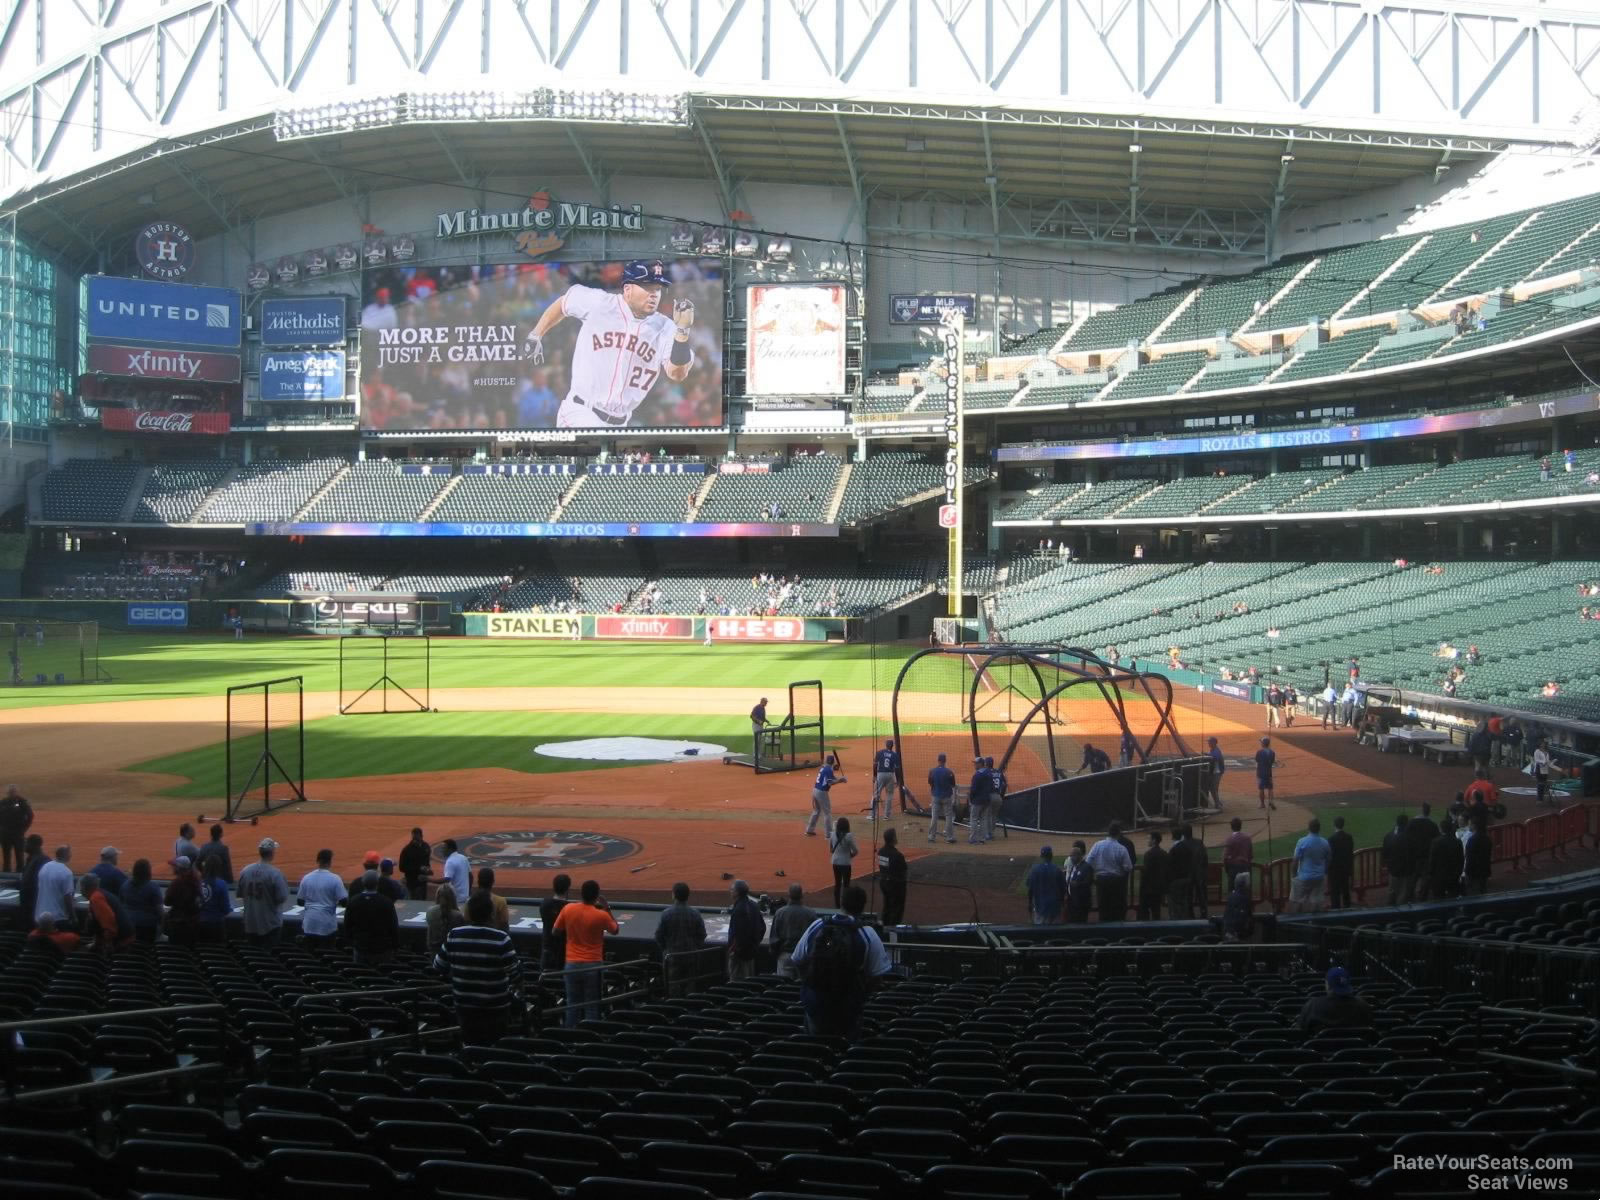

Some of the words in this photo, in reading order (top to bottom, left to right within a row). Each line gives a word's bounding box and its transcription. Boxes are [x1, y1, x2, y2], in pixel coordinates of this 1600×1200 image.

[437, 208, 552, 238] Minute
[559, 203, 643, 230] Maid
[144, 224, 190, 242] HOUSTON
[157, 240, 178, 261] H
[146, 262, 186, 277] ASTROS
[99, 300, 200, 321] UNITED
[935, 298, 955, 306] MLB
[267, 313, 341, 330] Methodist
[379, 327, 449, 345] MORE
[454, 326, 517, 343] THAN
[592, 331, 656, 363] ASTROS
[128, 351, 202, 378] xfinity
[378, 347, 423, 368] JUST
[427, 346, 443, 363] A
[447, 345, 523, 361] GAME.
[280, 382, 295, 391] The
[473, 377, 516, 386] #HUSTLE
[629, 366, 657, 391] 27
[1539, 402, 1556, 419] VS
[1200, 437, 1256, 452] ROYALS
[1277, 430, 1331, 447] ASTROS
[610, 464, 684, 474] ASTROS
[944, 448, 958, 504] FOUL
[463, 524, 521, 535] ROYALS
[545, 524, 605, 535] ASTROS
[131, 608, 185, 620] GEICO
[343, 602, 409, 614] LEXUS
[491, 617, 576, 633] STANLEY
[621, 617, 668, 634] xfinity
[718, 620, 794, 637] H-E-B
[883, 758, 891, 767] 6
[468, 858, 587, 868] STROS
